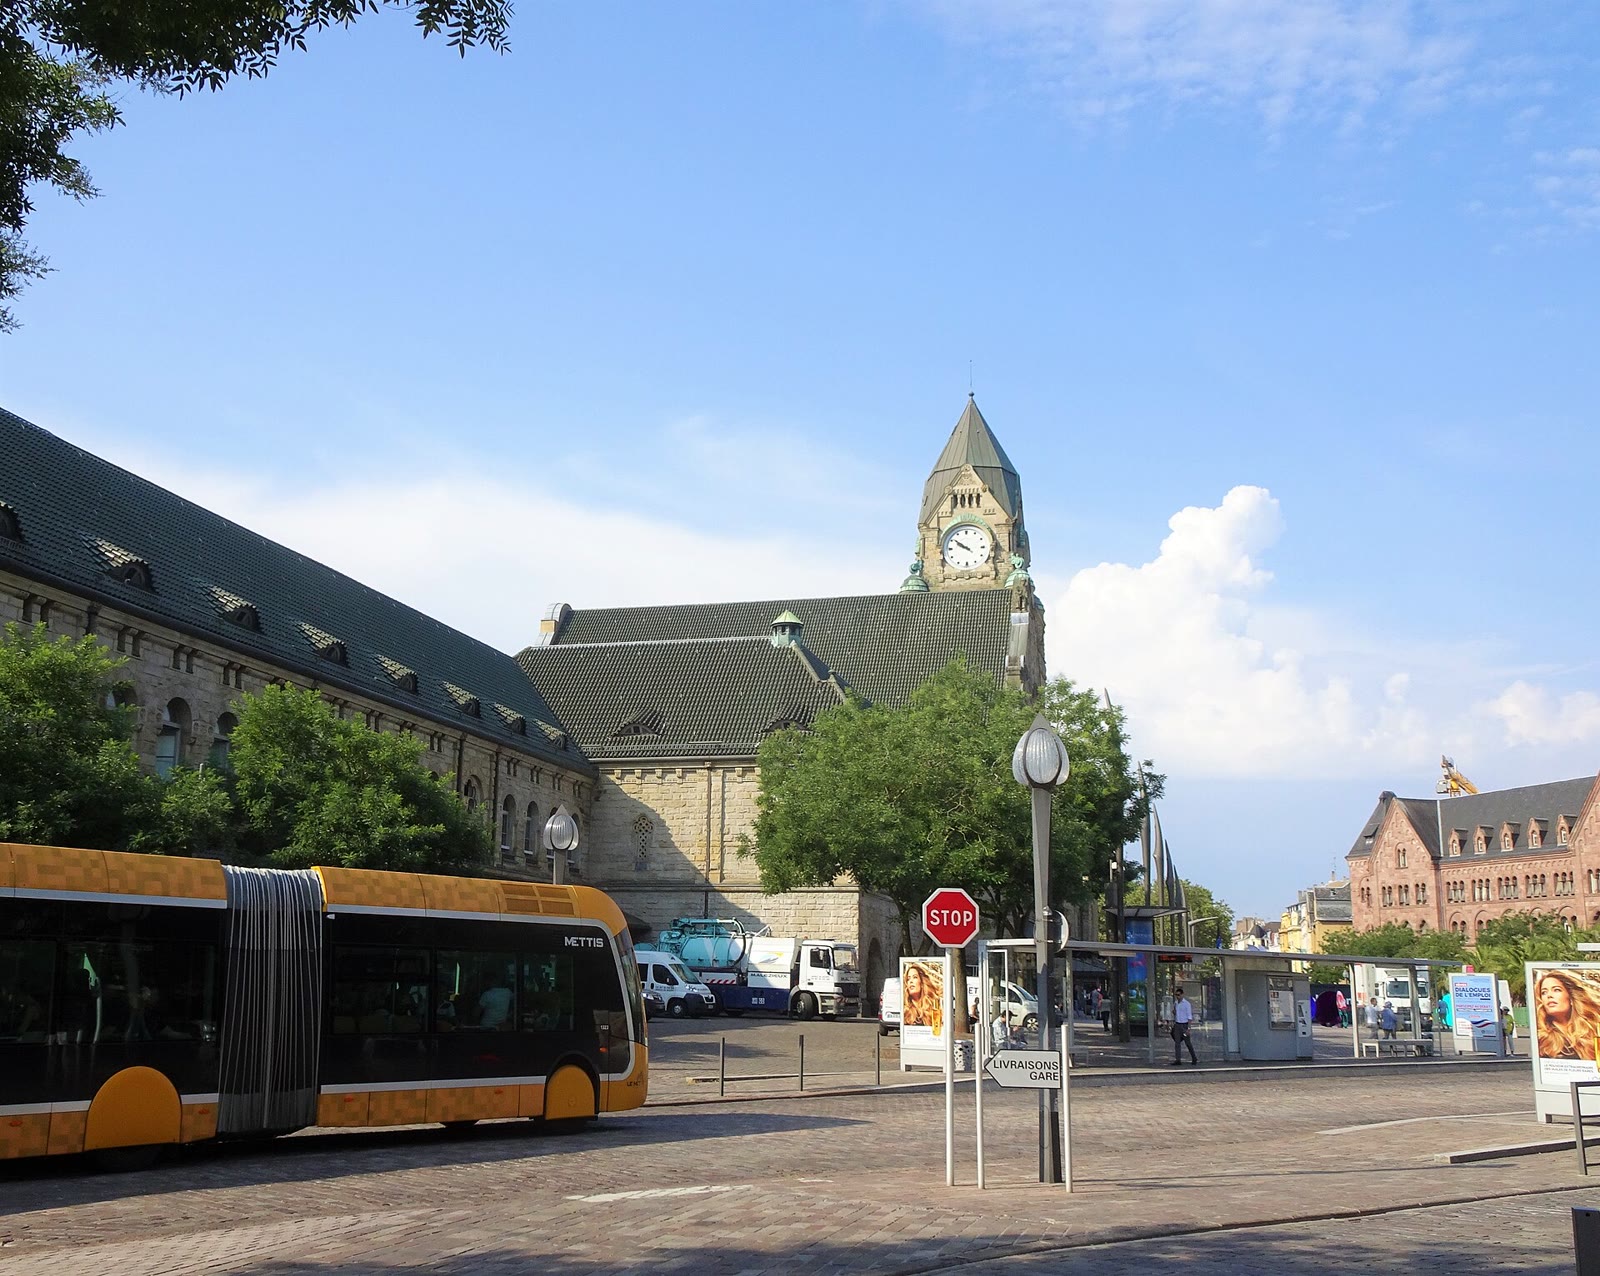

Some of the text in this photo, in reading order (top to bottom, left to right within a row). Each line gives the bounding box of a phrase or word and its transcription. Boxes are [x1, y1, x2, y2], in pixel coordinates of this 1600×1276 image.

[930, 909, 973, 927] STOP
[564, 936, 604, 948] METTIS
[1581, 972, 1600, 981] ELSE
[993, 1060, 1059, 1070] LIVRAISONS
[1029, 1071, 1059, 1081] GARE
